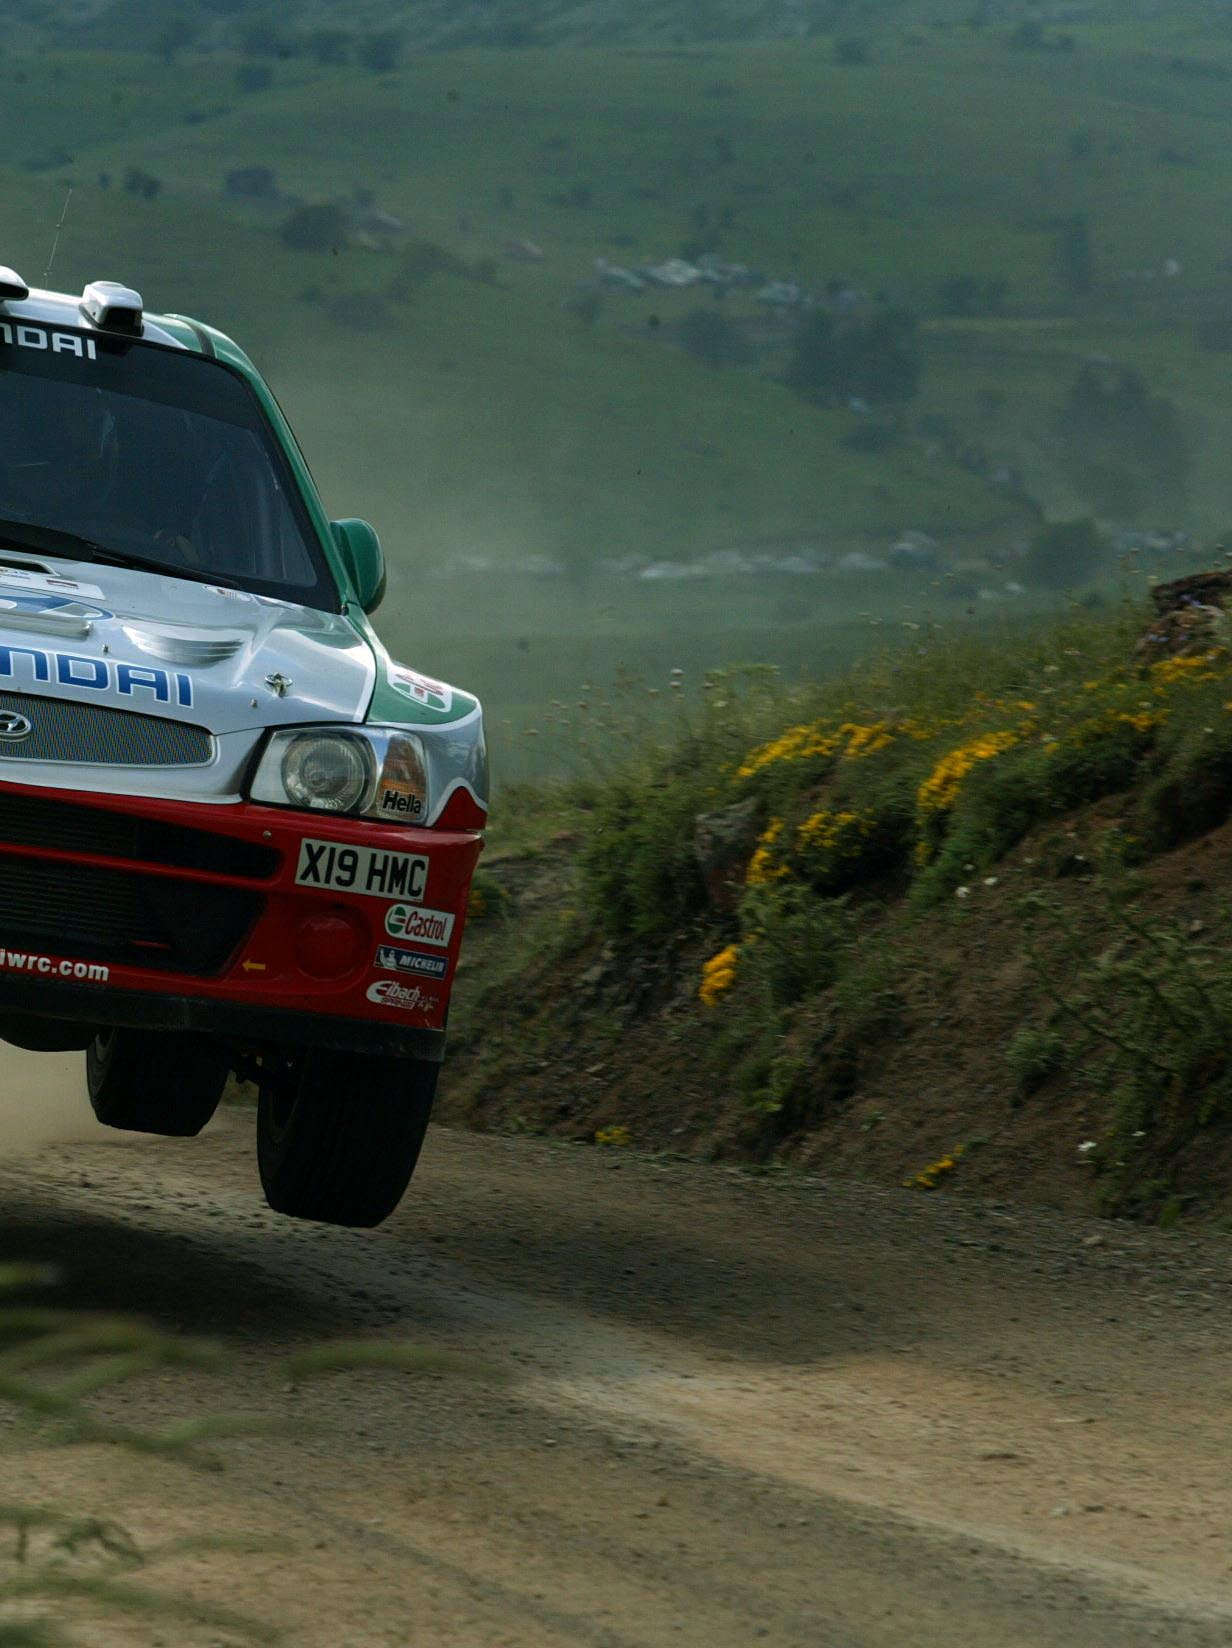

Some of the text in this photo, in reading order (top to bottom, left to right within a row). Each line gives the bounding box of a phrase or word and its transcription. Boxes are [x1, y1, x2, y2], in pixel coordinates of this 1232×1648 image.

[382, 790, 423, 814] Hella
[300, 843, 426, 897] X19 HMC
[405, 910, 448, 941] Castrol
[399, 955, 445, 973] MICHELIN
